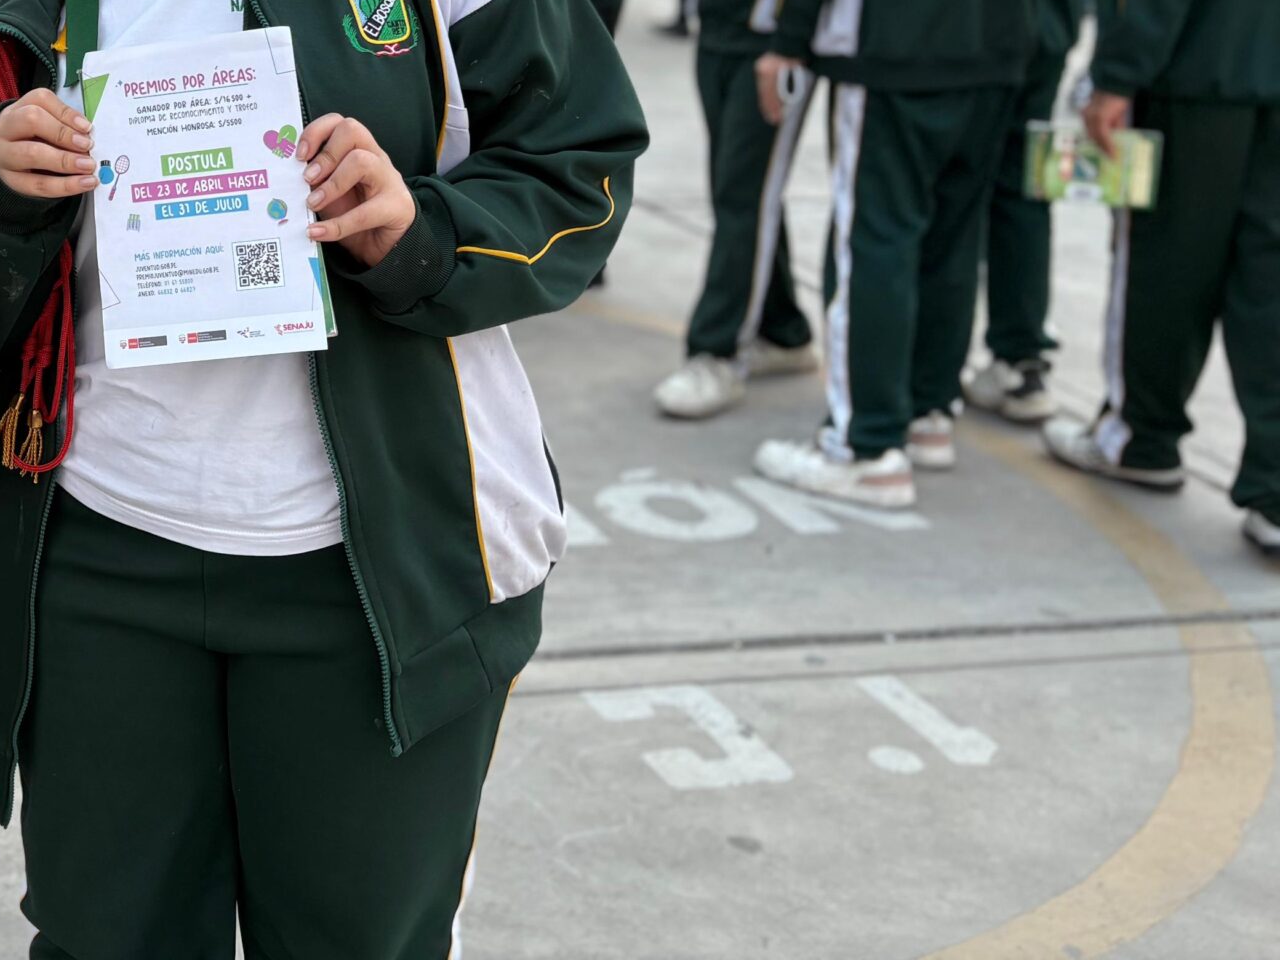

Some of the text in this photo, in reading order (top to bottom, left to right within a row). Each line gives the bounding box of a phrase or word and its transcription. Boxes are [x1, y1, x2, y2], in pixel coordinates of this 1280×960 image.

[124, 65, 257, 98] PREMIOS POR ÁREAS:
[136, 102, 170, 114] GANADOR
[173, 100, 187, 110] POR
[190, 96, 212, 109] ÁREA:
[146, 124, 178, 136] MENCIÓN
[167, 152, 227, 174] POSTULA
[133, 186, 153, 200] DEL
[157, 184, 171, 197] 23
[193, 179, 224, 194] ABRIL
[228, 173, 266, 189] HASTA
[161, 197, 242, 218] EL 31 DE JULIO
[134, 249, 151, 262] MÁS
[153, 245, 202, 260] INFORMACIÓN
[282, 321, 314, 331] SENAJU
